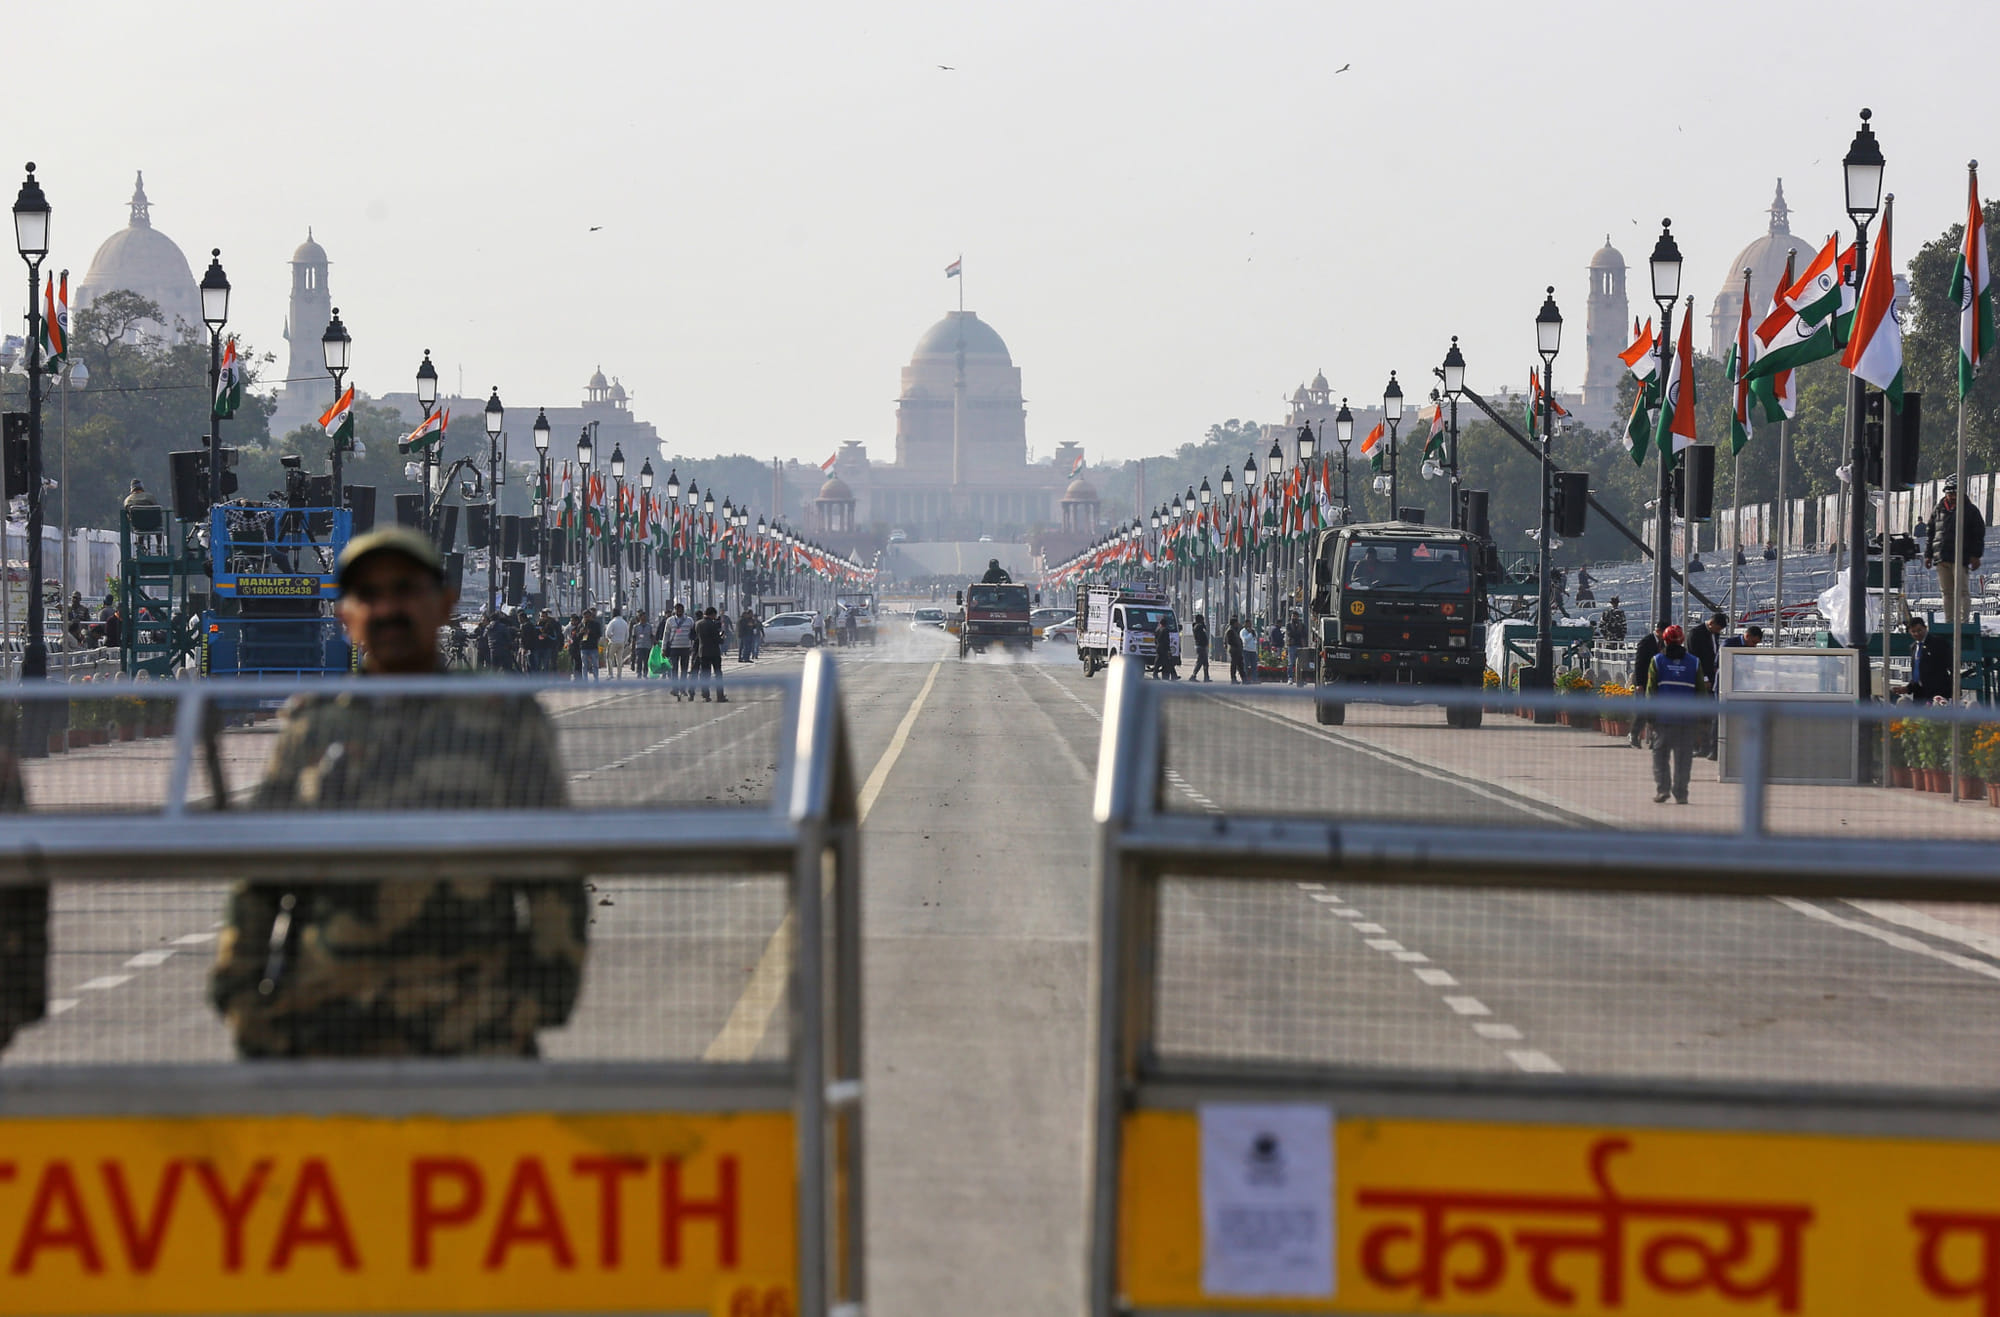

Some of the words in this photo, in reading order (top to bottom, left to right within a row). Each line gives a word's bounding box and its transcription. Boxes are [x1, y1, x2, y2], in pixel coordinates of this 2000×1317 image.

[239, 578, 292, 586] MANLIFT
[252, 587, 312, 595] 18001025438
[0, 1157, 362, 1275] AVYA
[410, 1154, 741, 1272] PATH
